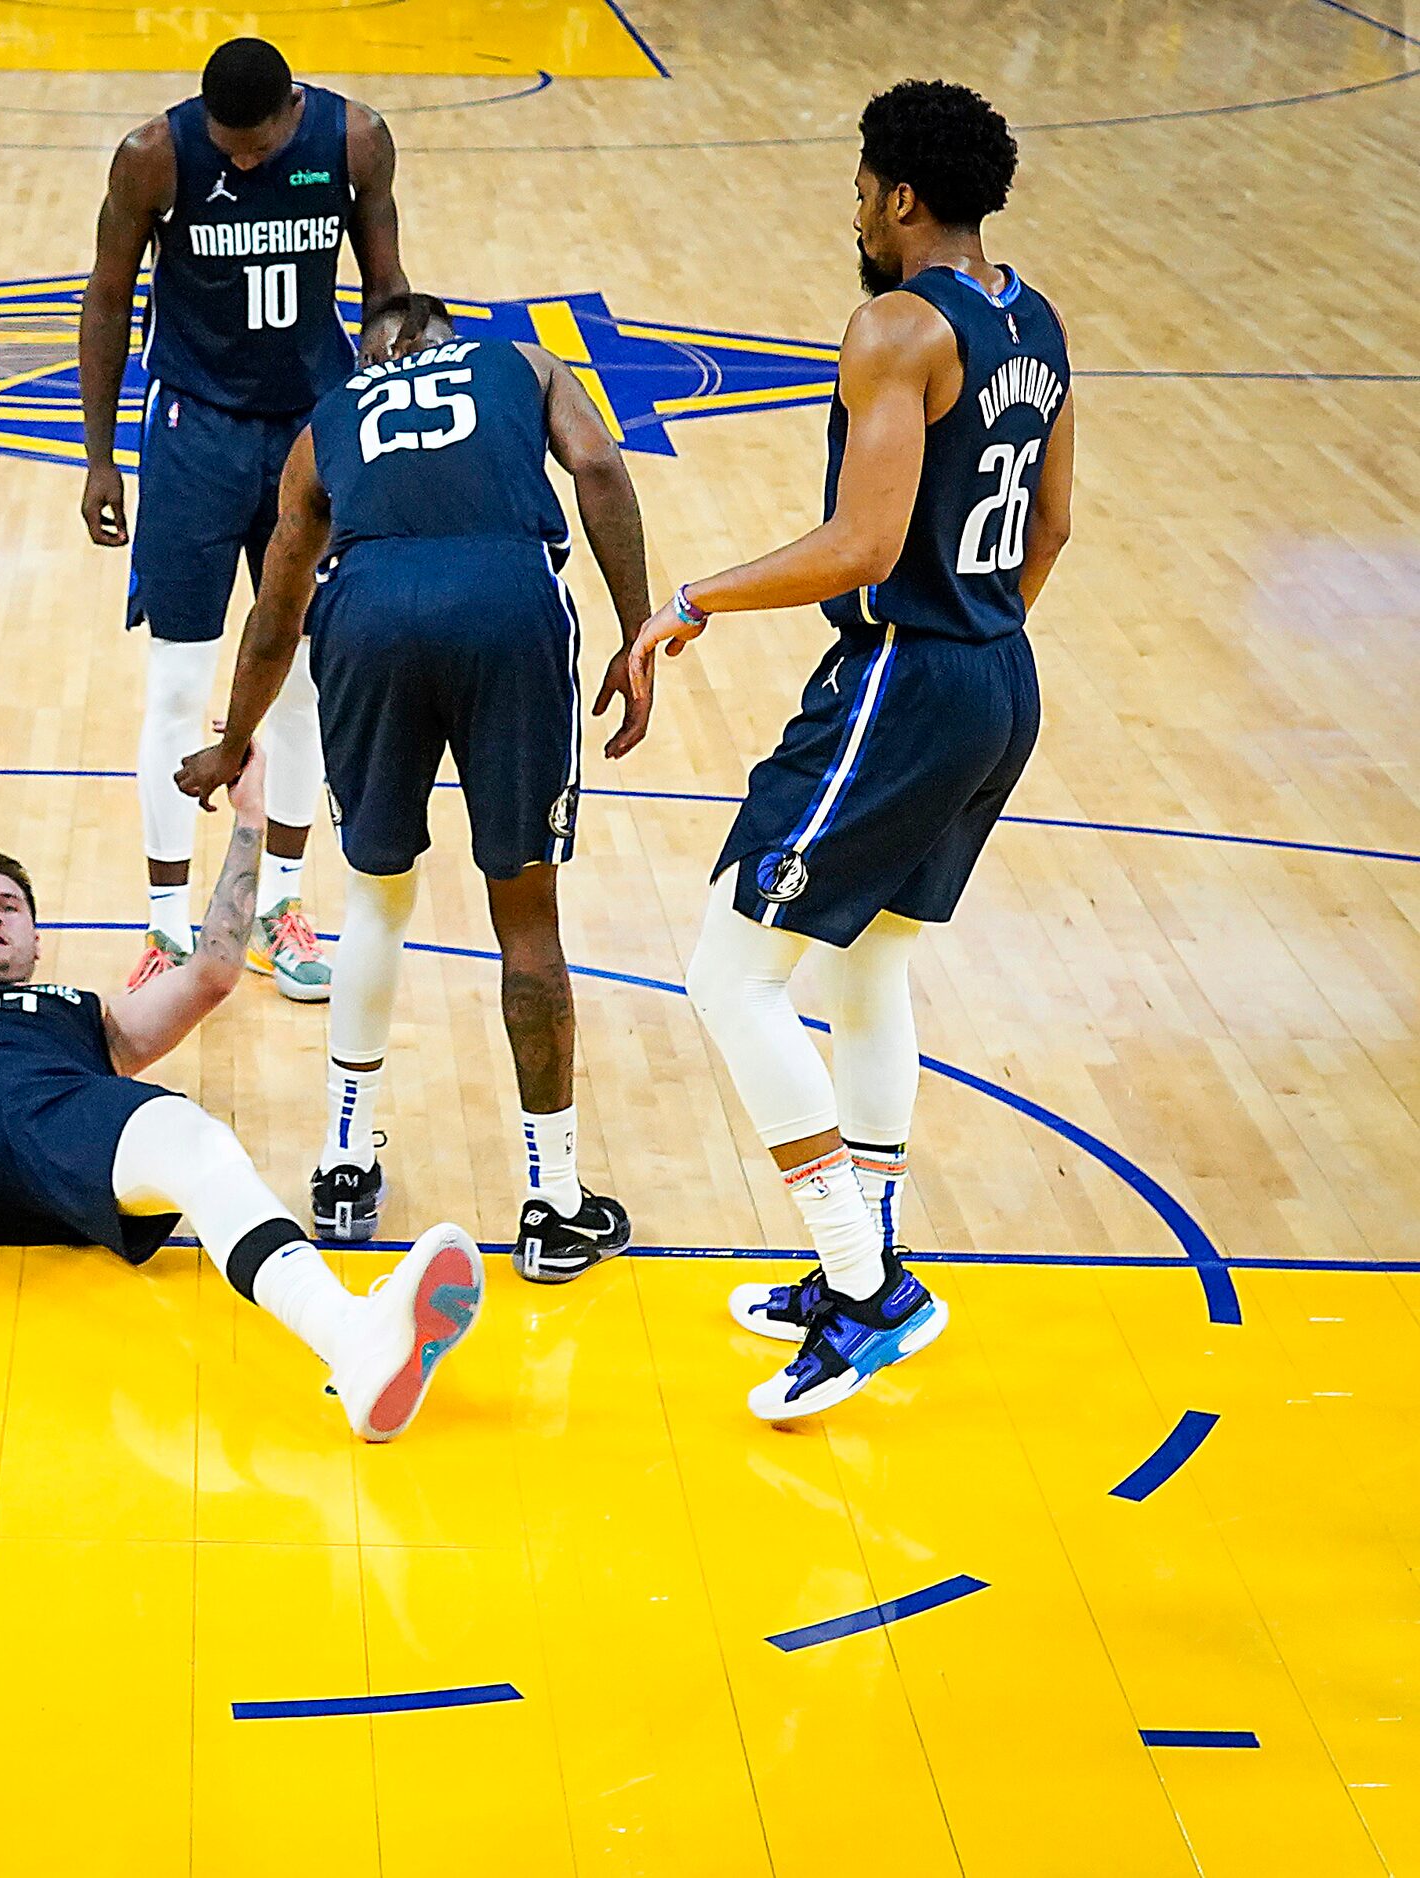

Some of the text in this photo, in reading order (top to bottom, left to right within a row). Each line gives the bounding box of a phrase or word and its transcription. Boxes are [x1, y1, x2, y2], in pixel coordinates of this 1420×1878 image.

[189, 215, 340, 257] MAVERICKS
[243, 263, 298, 330] 10
[357, 367, 477, 464] 25
[978, 356, 1063, 430] DINWIDDIE
[956, 438, 1042, 575] 26
